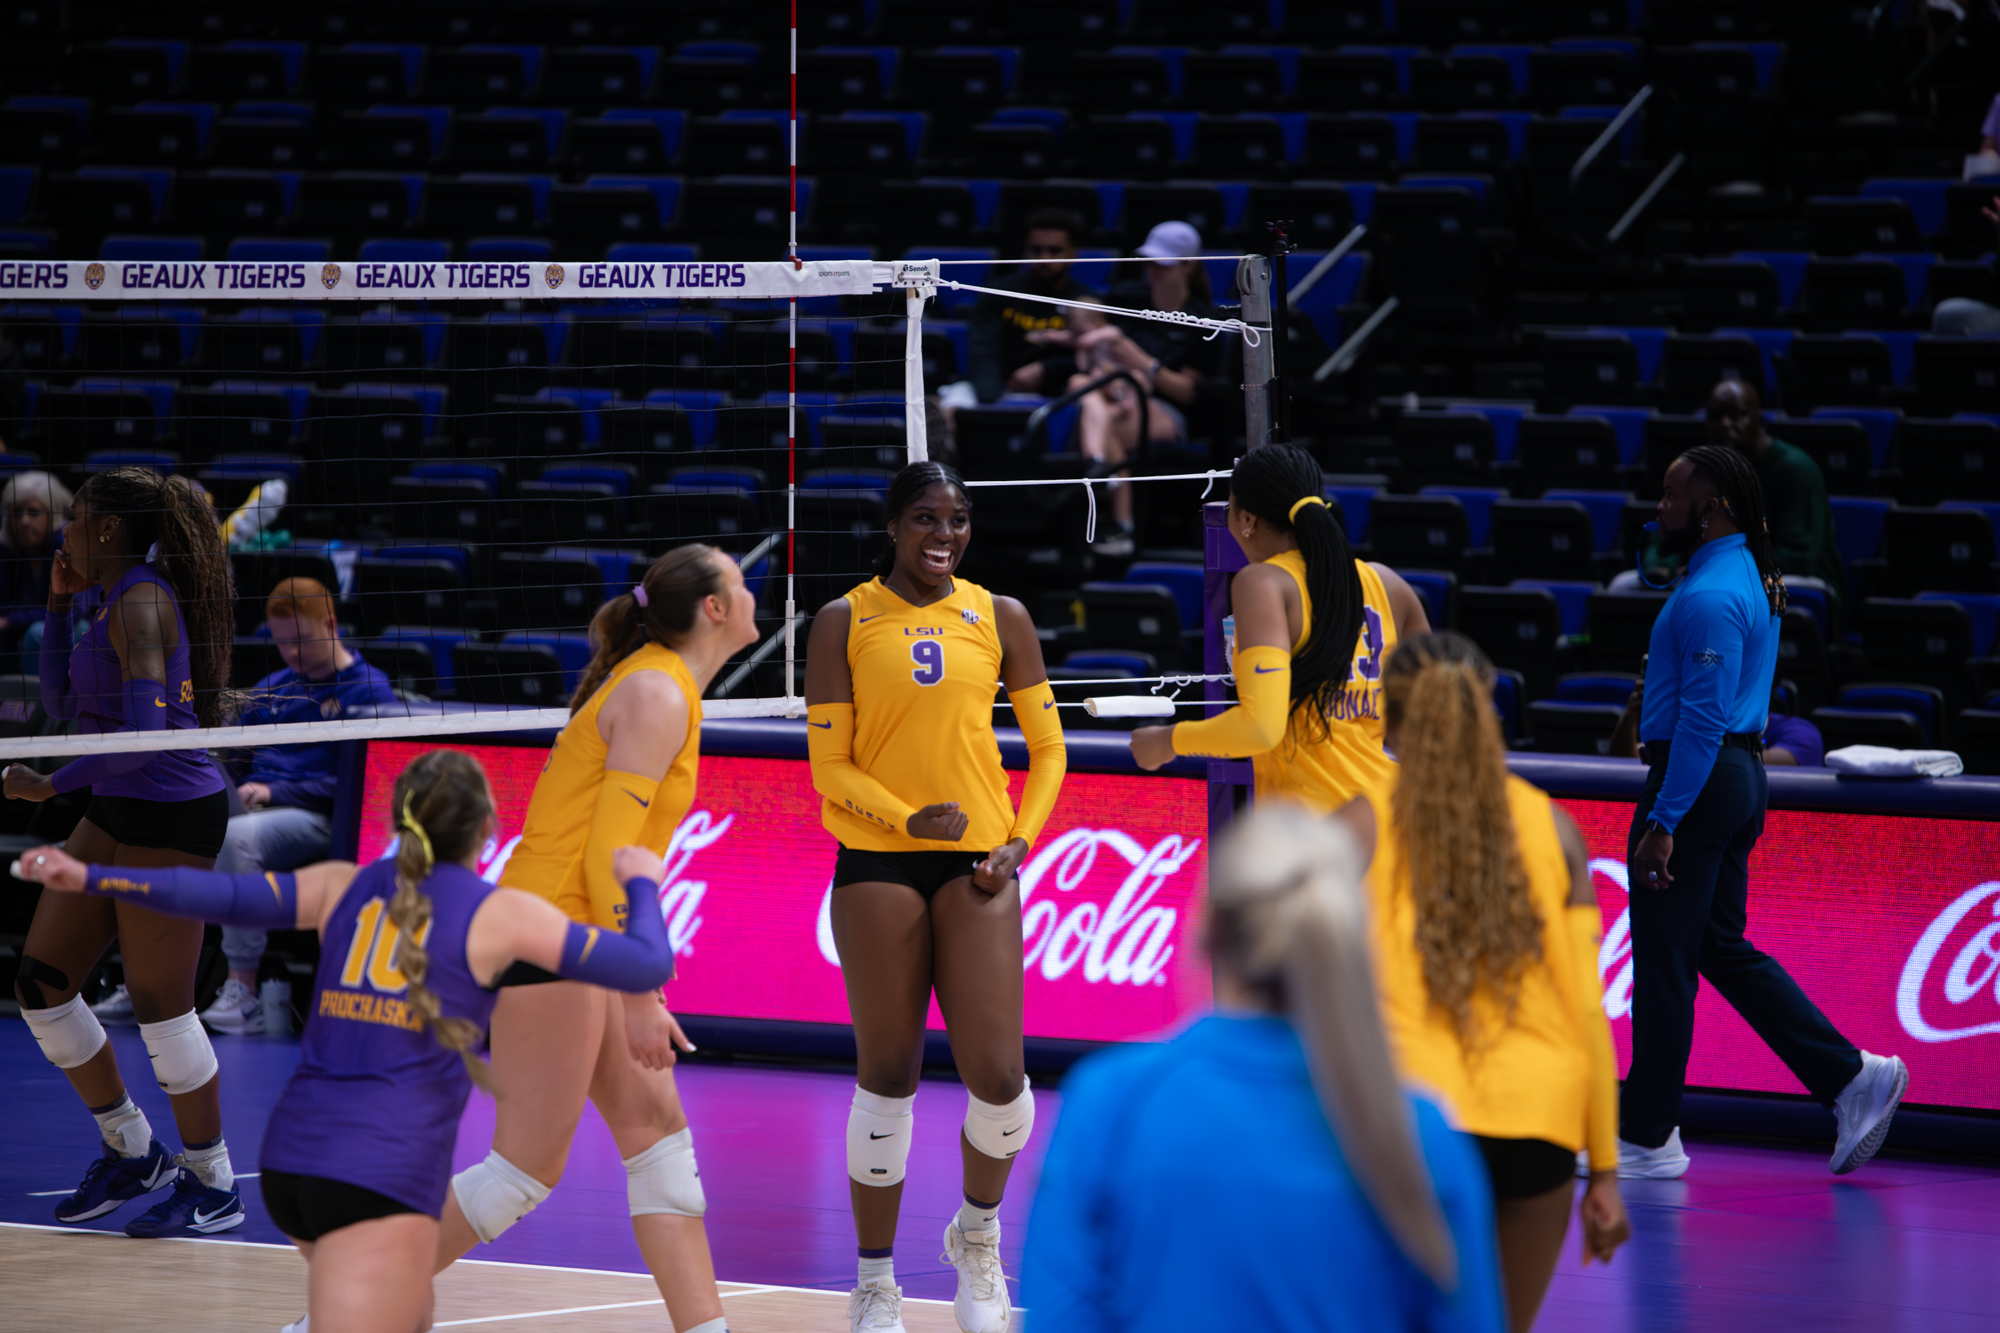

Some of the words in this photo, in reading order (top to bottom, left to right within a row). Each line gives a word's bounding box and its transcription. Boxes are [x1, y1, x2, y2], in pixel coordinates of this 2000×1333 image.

[1, 264, 68, 289] GERS
[122, 264, 206, 289] GEAUX
[214, 263, 306, 289] TIGERS
[356, 263, 437, 289] GEAUX
[444, 263, 530, 288] TIGERS
[578, 263, 656, 288] GEAUX
[662, 263, 746, 288] TIGERS
[904, 627, 944, 636] LSU
[1346, 604, 1386, 683] 3
[910, 639, 945, 687] 9
[339, 895, 434, 995] 10
